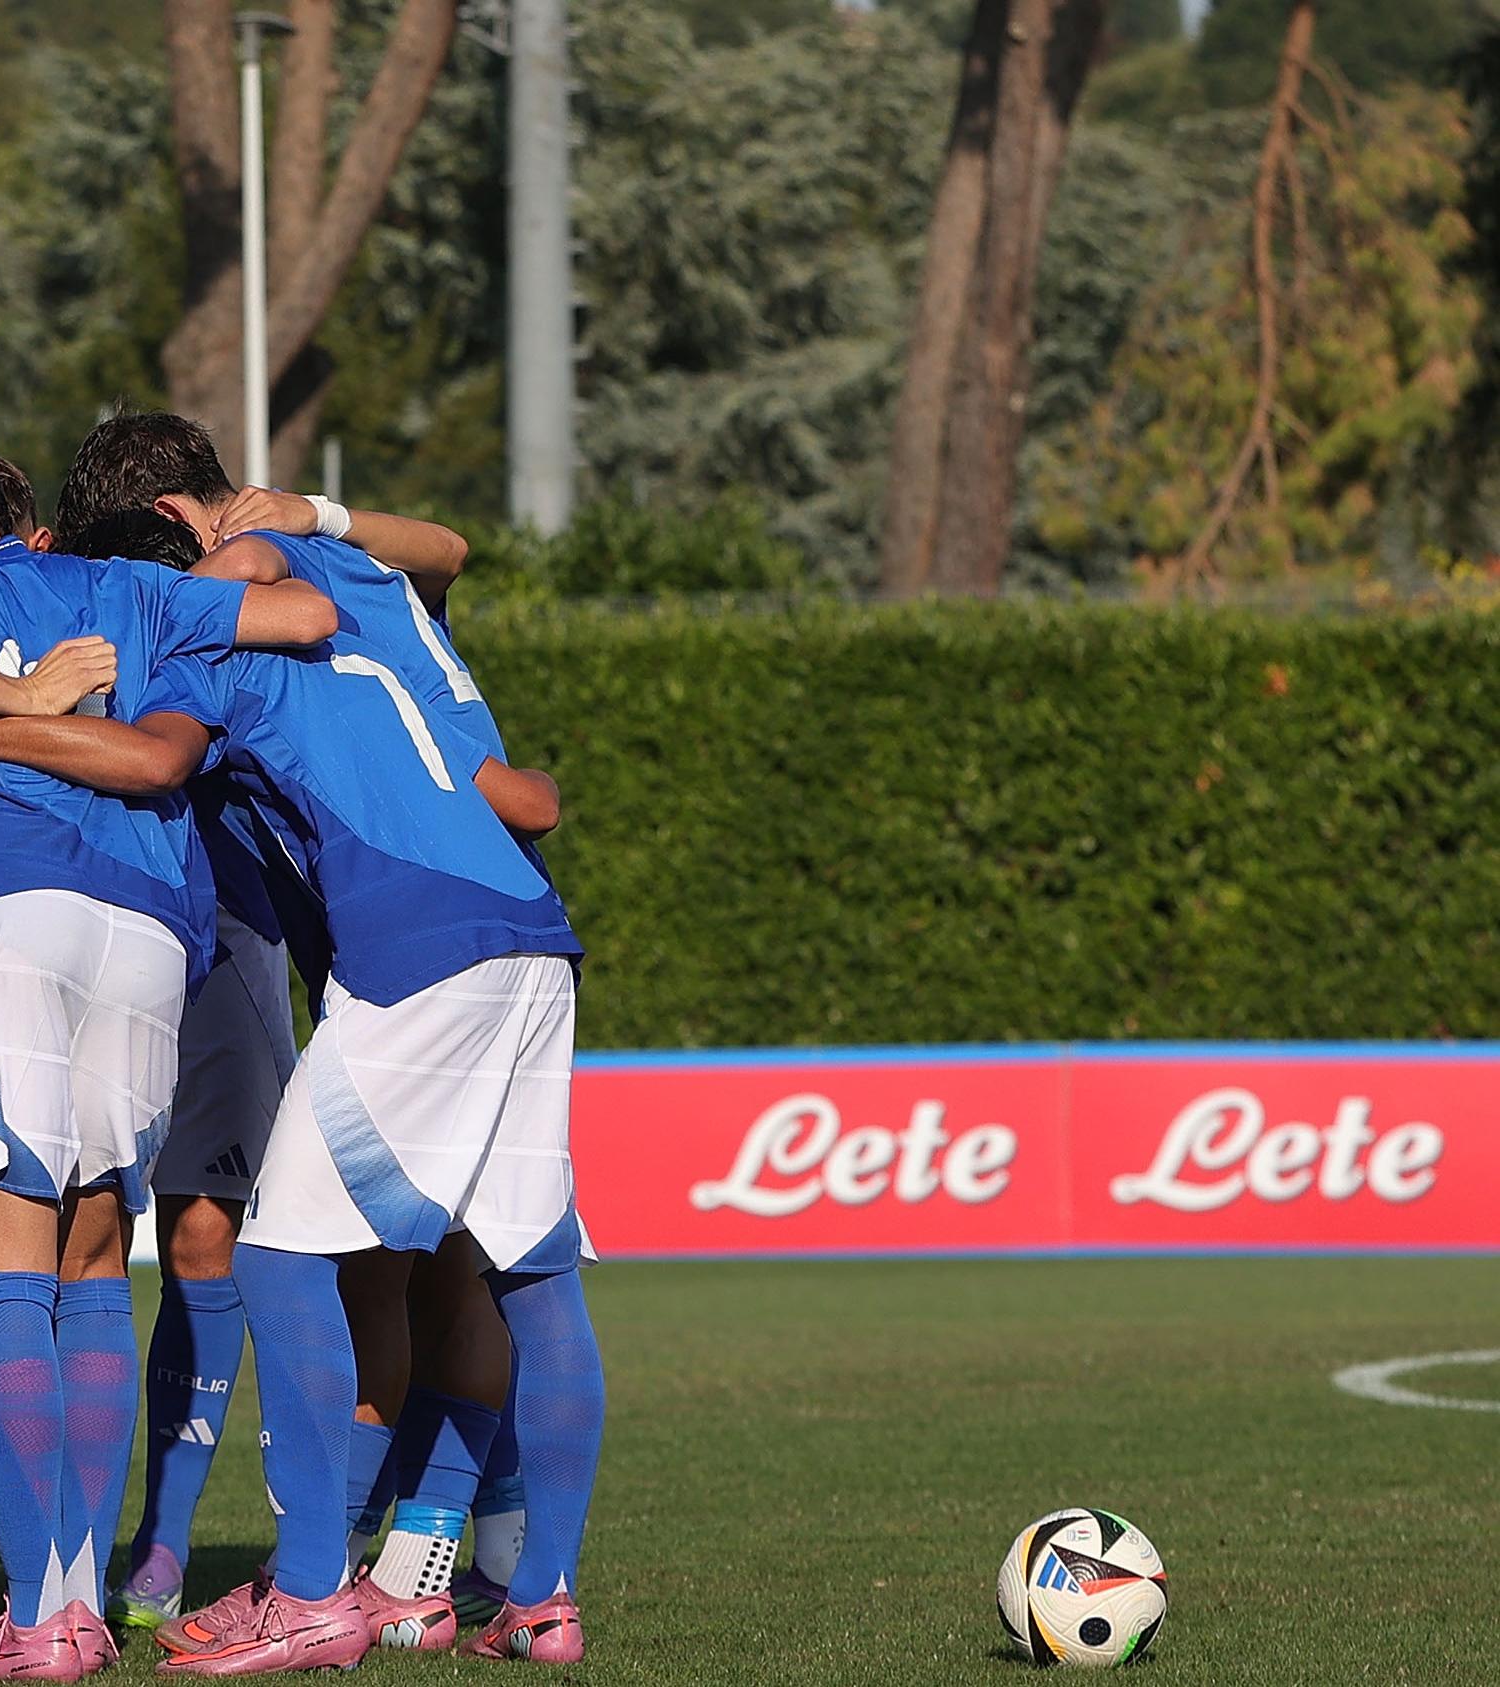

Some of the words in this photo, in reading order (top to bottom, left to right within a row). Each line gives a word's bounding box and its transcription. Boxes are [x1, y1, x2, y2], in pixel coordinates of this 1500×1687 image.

[688, 1092, 1019, 1217] Lete
[1110, 1086, 1445, 1212] Lete
[157, 1366, 229, 1395] ITALIA
